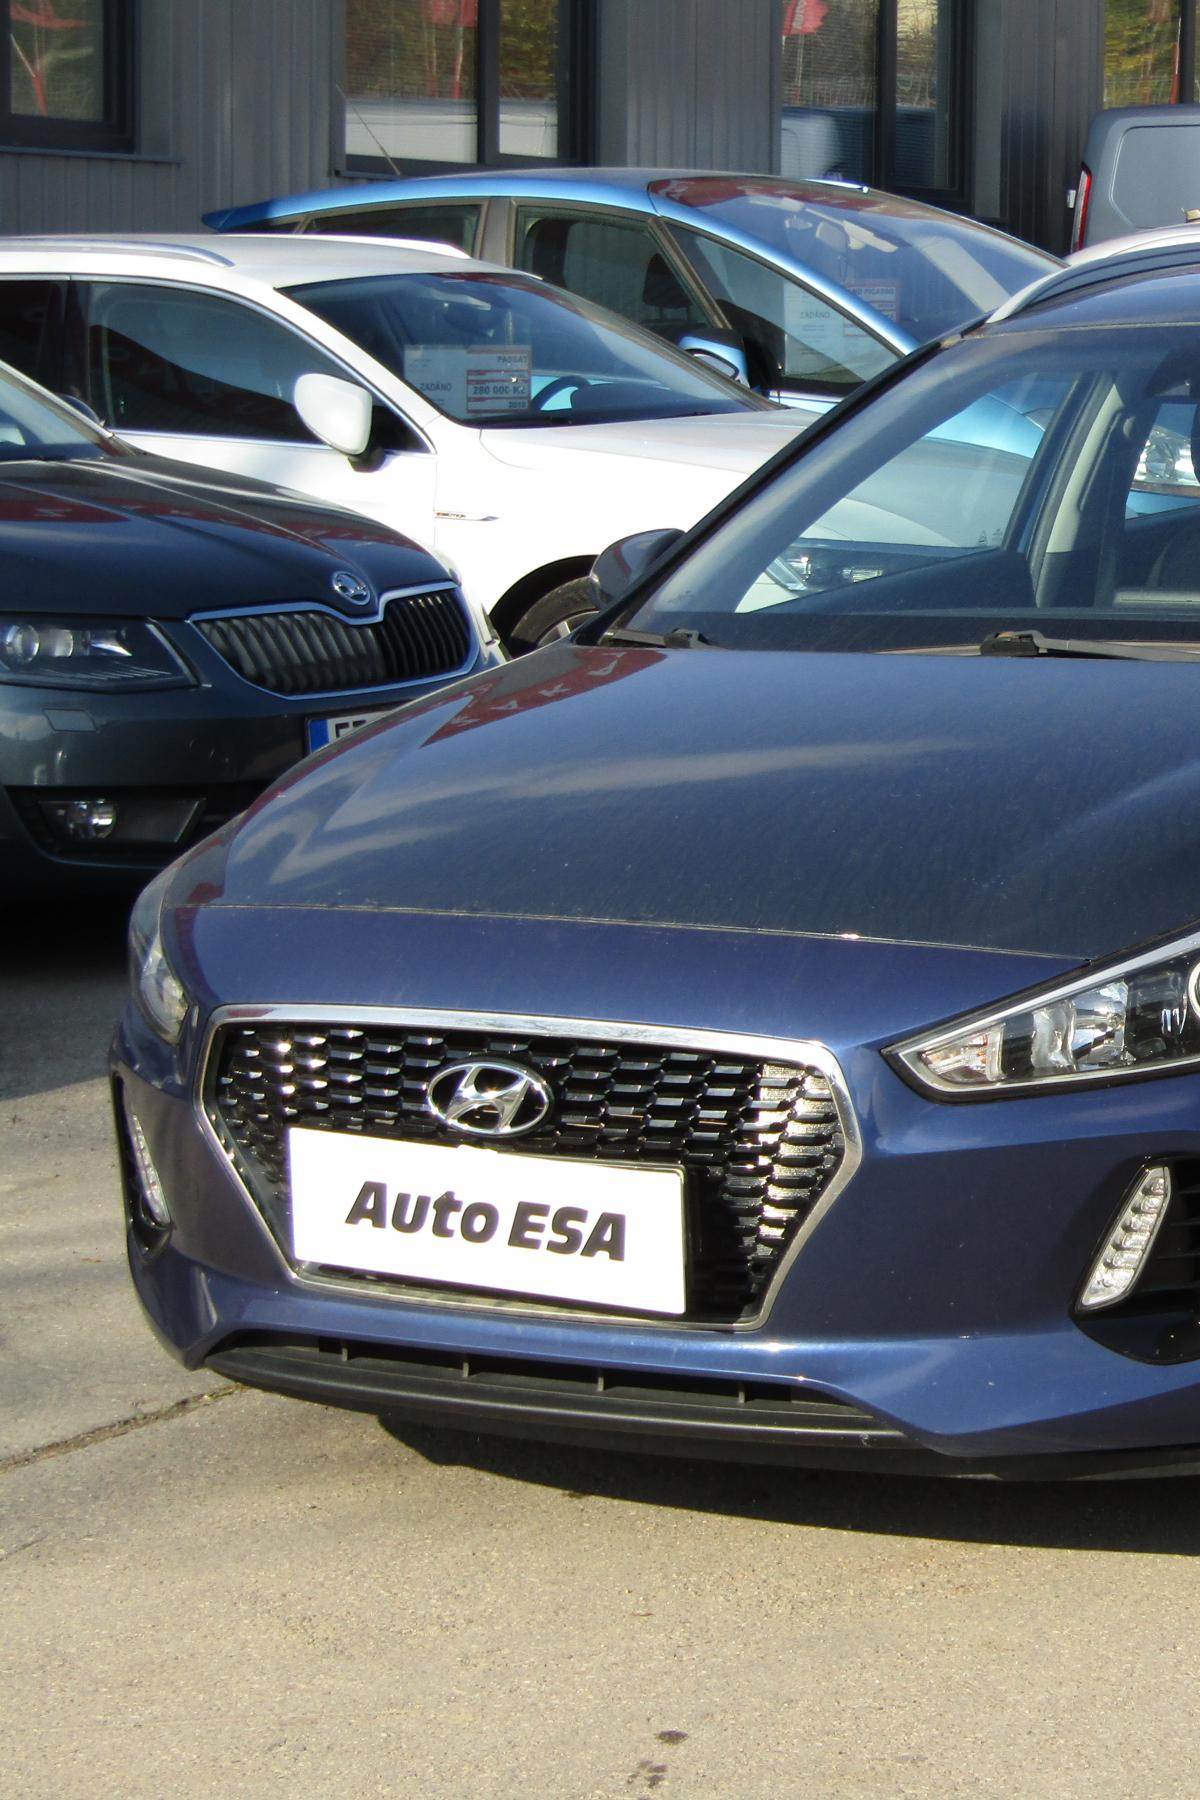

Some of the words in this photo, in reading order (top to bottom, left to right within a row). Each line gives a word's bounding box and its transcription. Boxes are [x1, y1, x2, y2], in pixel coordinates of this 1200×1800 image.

[497, 355, 528, 363] PASSAT
[345, 1180, 499, 1244] Auto
[507, 1201, 626, 1262] ESA
